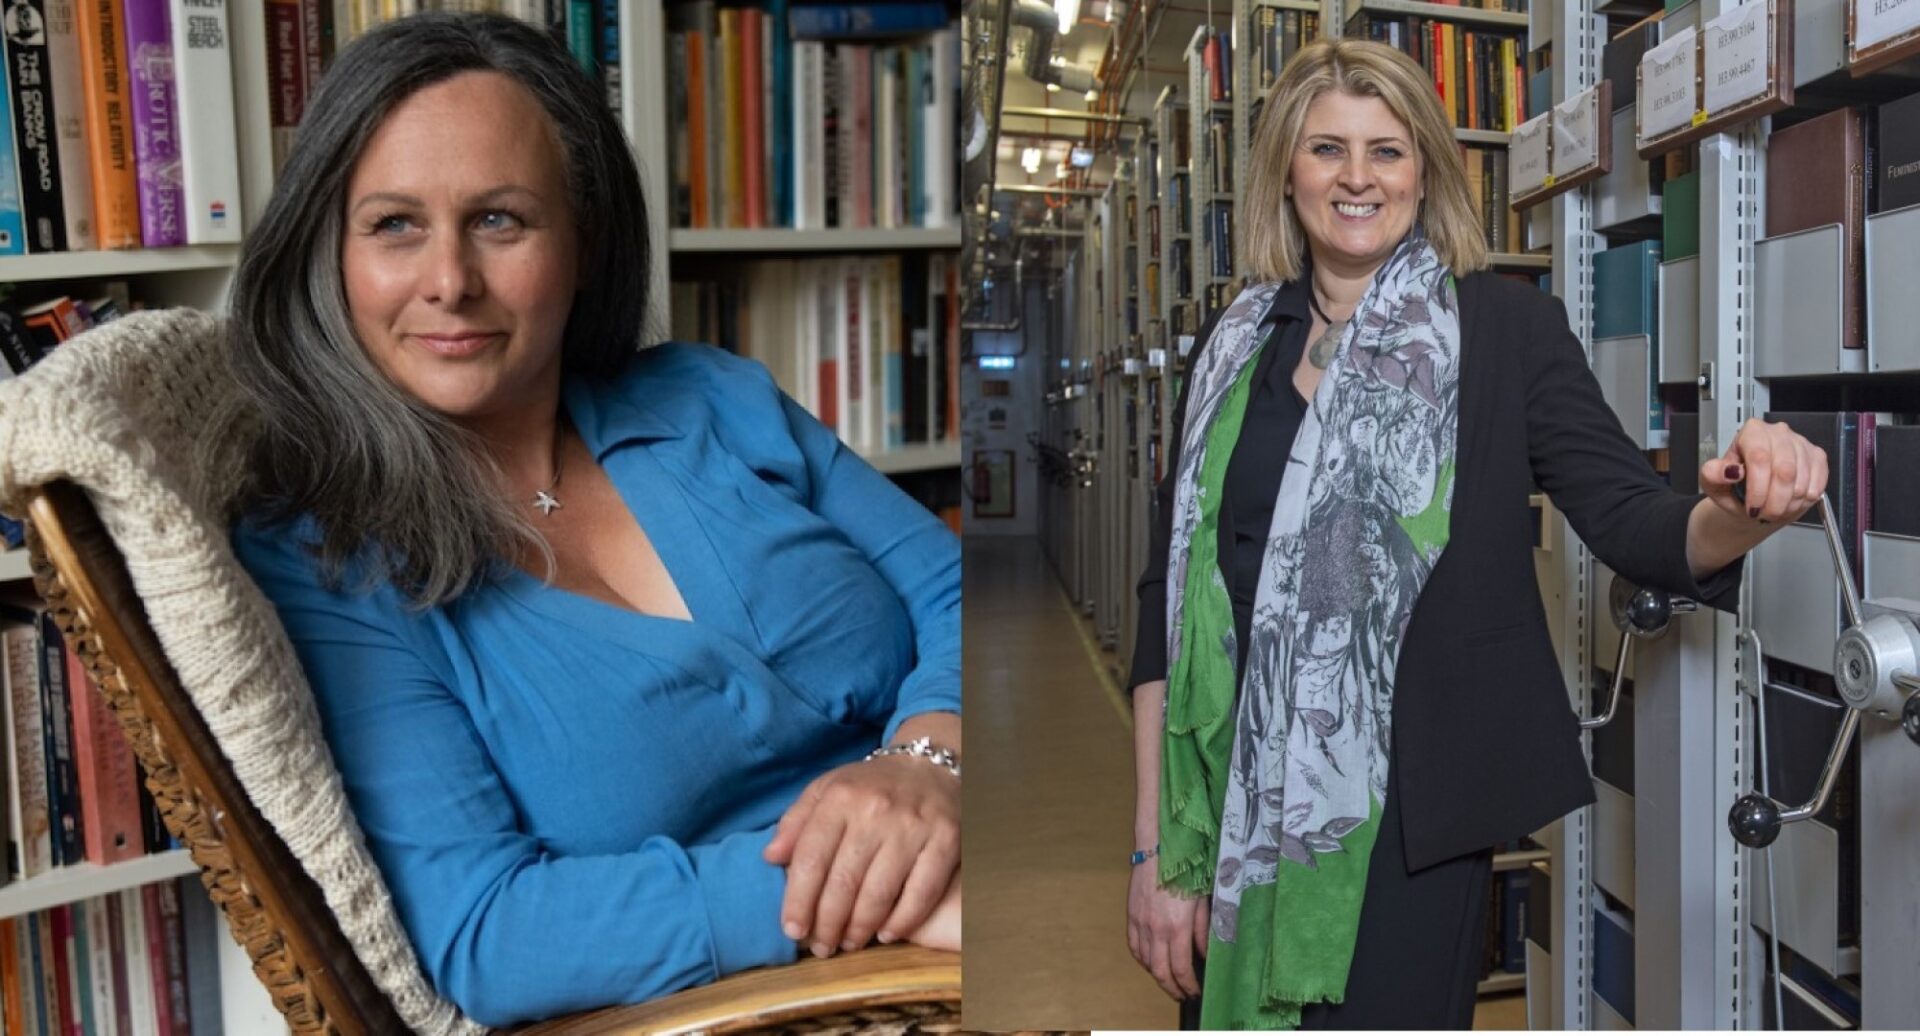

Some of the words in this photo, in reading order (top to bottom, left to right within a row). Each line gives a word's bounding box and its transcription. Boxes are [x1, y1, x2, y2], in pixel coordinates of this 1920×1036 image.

[187, 15, 221, 32] STEEL
[187, 32, 224, 49] BEACH
[17, 52, 31, 86] IAN
[27, 50, 41, 85] THE
[21, 90, 38, 150] BANKS
[31, 89, 46, 140] CROW
[106, 101, 126, 171] RELATIVITY
[37, 143, 52, 191] ROAD
